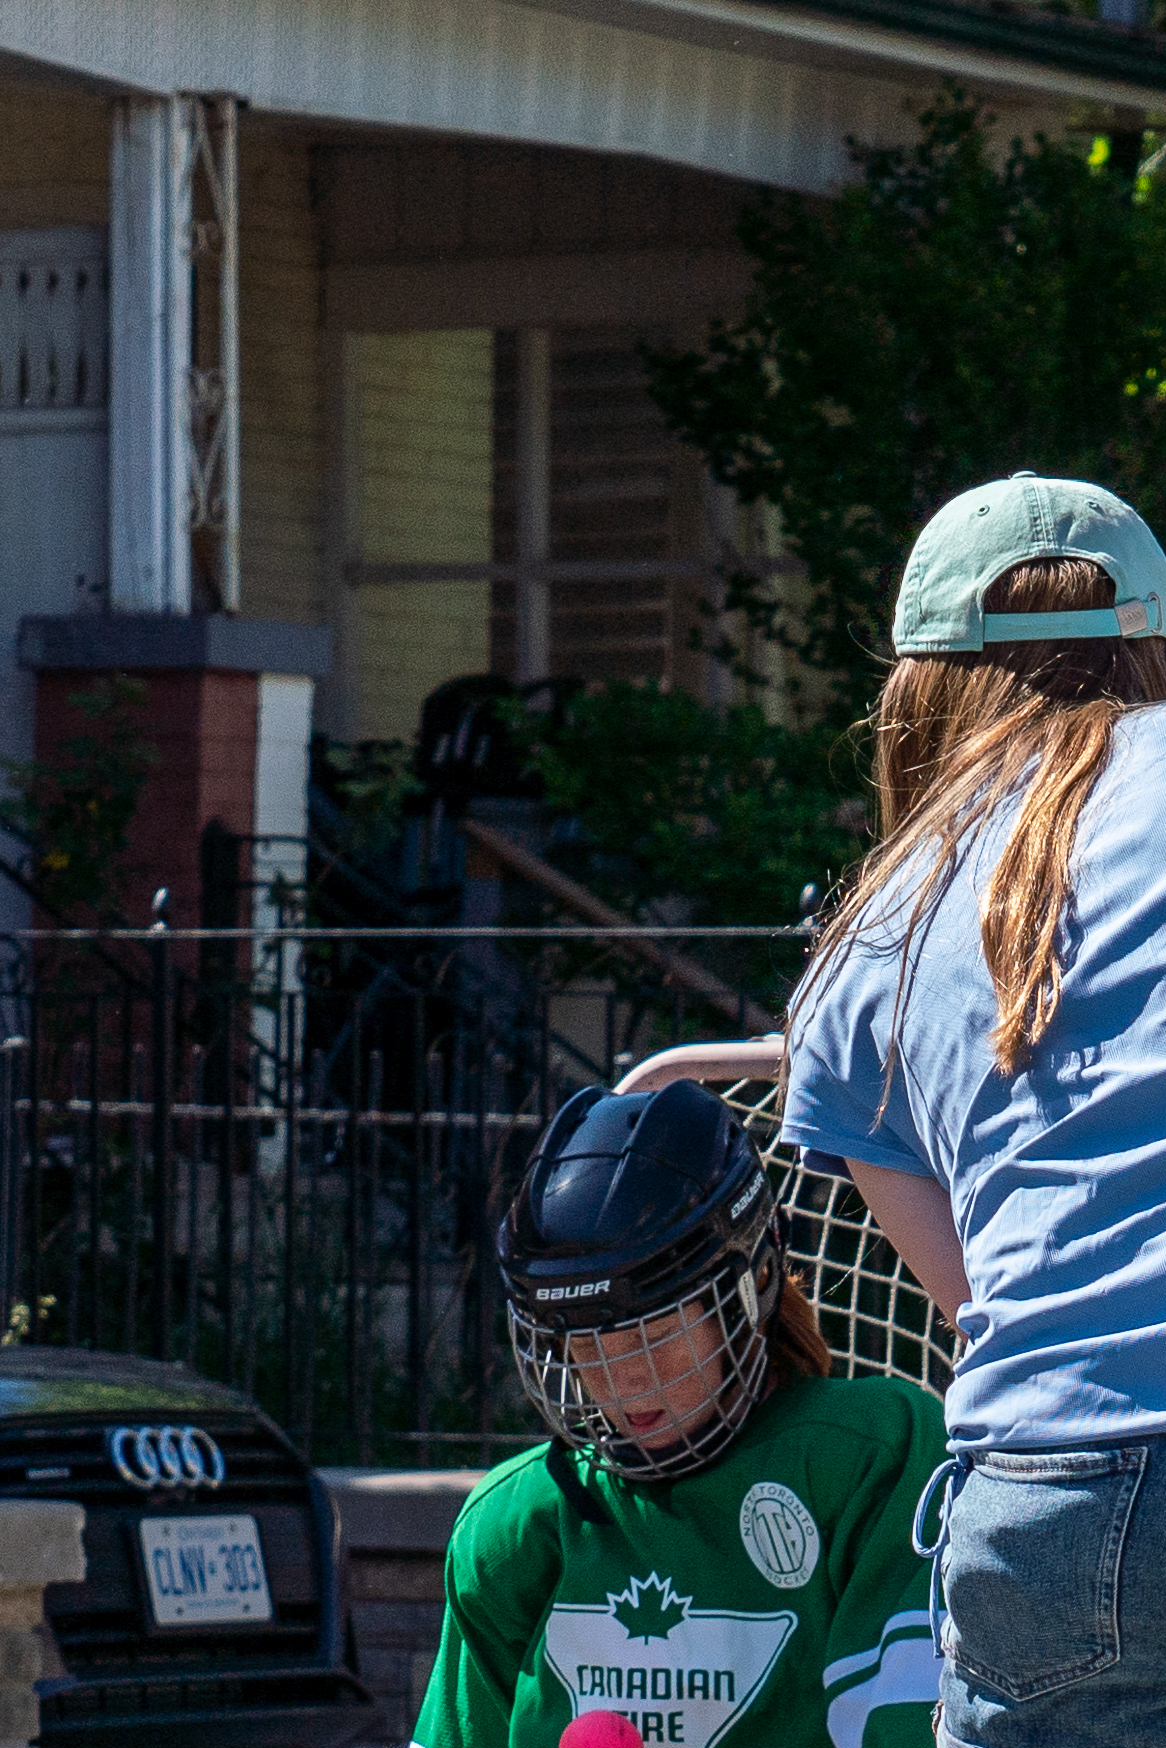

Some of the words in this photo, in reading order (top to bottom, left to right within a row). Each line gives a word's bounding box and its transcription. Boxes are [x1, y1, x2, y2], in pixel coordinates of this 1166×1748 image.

[536, 1279, 611, 1300] BAUER
[758, 1486, 815, 1536] TORONTO
[577, 1665, 735, 1702] CANADIAN
